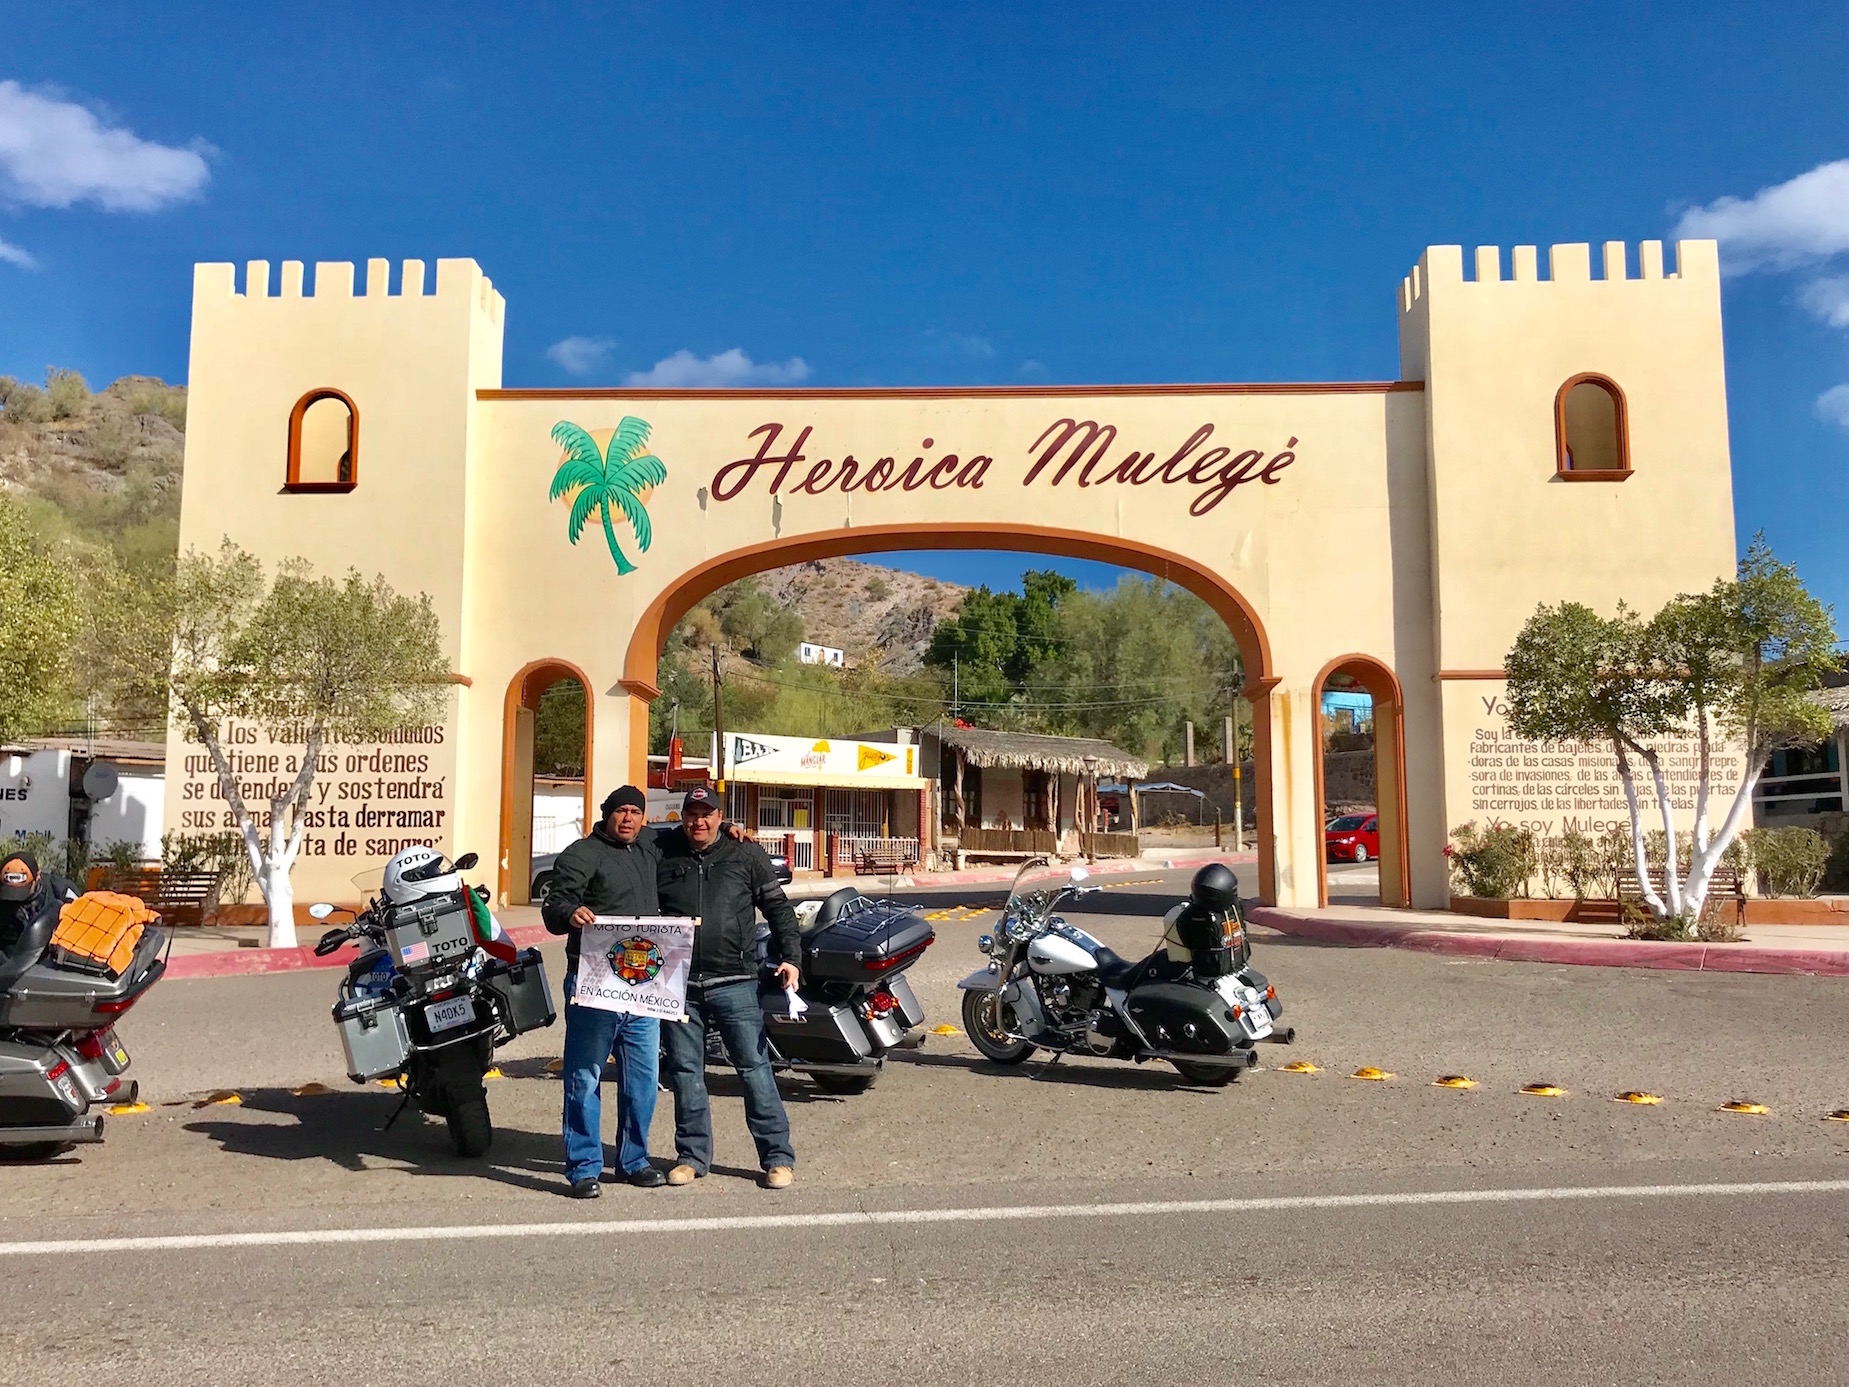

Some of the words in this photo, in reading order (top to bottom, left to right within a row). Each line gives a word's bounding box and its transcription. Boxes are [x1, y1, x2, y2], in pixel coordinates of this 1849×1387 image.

[711, 423, 993, 501] Heroica
[1022, 418, 1299, 517] Mulegé
[1481, 696, 1508, 716] Yo
[227, 721, 258, 745] los
[1475, 728, 1498, 743] Soy
[1501, 726, 1512, 740] la
[741, 740, 774, 761] BAR
[1541, 742, 1555, 754] de
[184, 754, 218, 778] que
[226, 749, 280, 774] tiene
[285, 755, 298, 774] a
[345, 748, 429, 774] ordenes
[1506, 755, 1520, 768] de
[1523, 755, 1539, 768] las
[1541, 757, 1575, 768] casas
[1578, 756, 1637, 769] misionas,
[1668, 757, 1706, 770] sangr
[1499, 768, 1513, 782] de
[1577, 768, 1591, 781] de
[1594, 768, 1609, 781] las
[1611, 770, 1644, 783] aas
[1646, 768, 1723, 781] ctendiees
[1726, 768, 1739, 781] de
[182, 782, 205, 800] se
[210, 775, 313, 800] dfende
[316, 782, 332, 805] y
[337, 775, 447, 800] sostendrá
[1522, 782, 1536, 796] de
[1537, 782, 1553, 796] las
[1555, 782, 1600, 796] cárceles
[1602, 784, 1619, 796] sin
[1623, 785, 1654, 798] rjas,
[1671, 782, 1687, 796] las
[1472, 797, 1488, 810] sin
[1541, 798, 1554, 810] de
[1556, 798, 1572, 810] las
[1574, 797, 1629, 810] libertades
[181, 810, 216, 828] sus
[222, 810, 276, 828] ama
[355, 803, 446, 828] derramar
[1519, 820, 1554, 836] soy
[1562, 816, 1632, 837] Mulegé
[334, 831, 358, 856] de
[396, 852, 431, 868] TOTO
[593, 923, 632, 933] MOTO
[636, 924, 683, 935] TURISTA
[432, 936, 468, 953] TOTO
[580, 985, 594, 996] EN
[595, 988, 638, 1002] ACCIÓN
[640, 993, 680, 1009] MÉXICO
